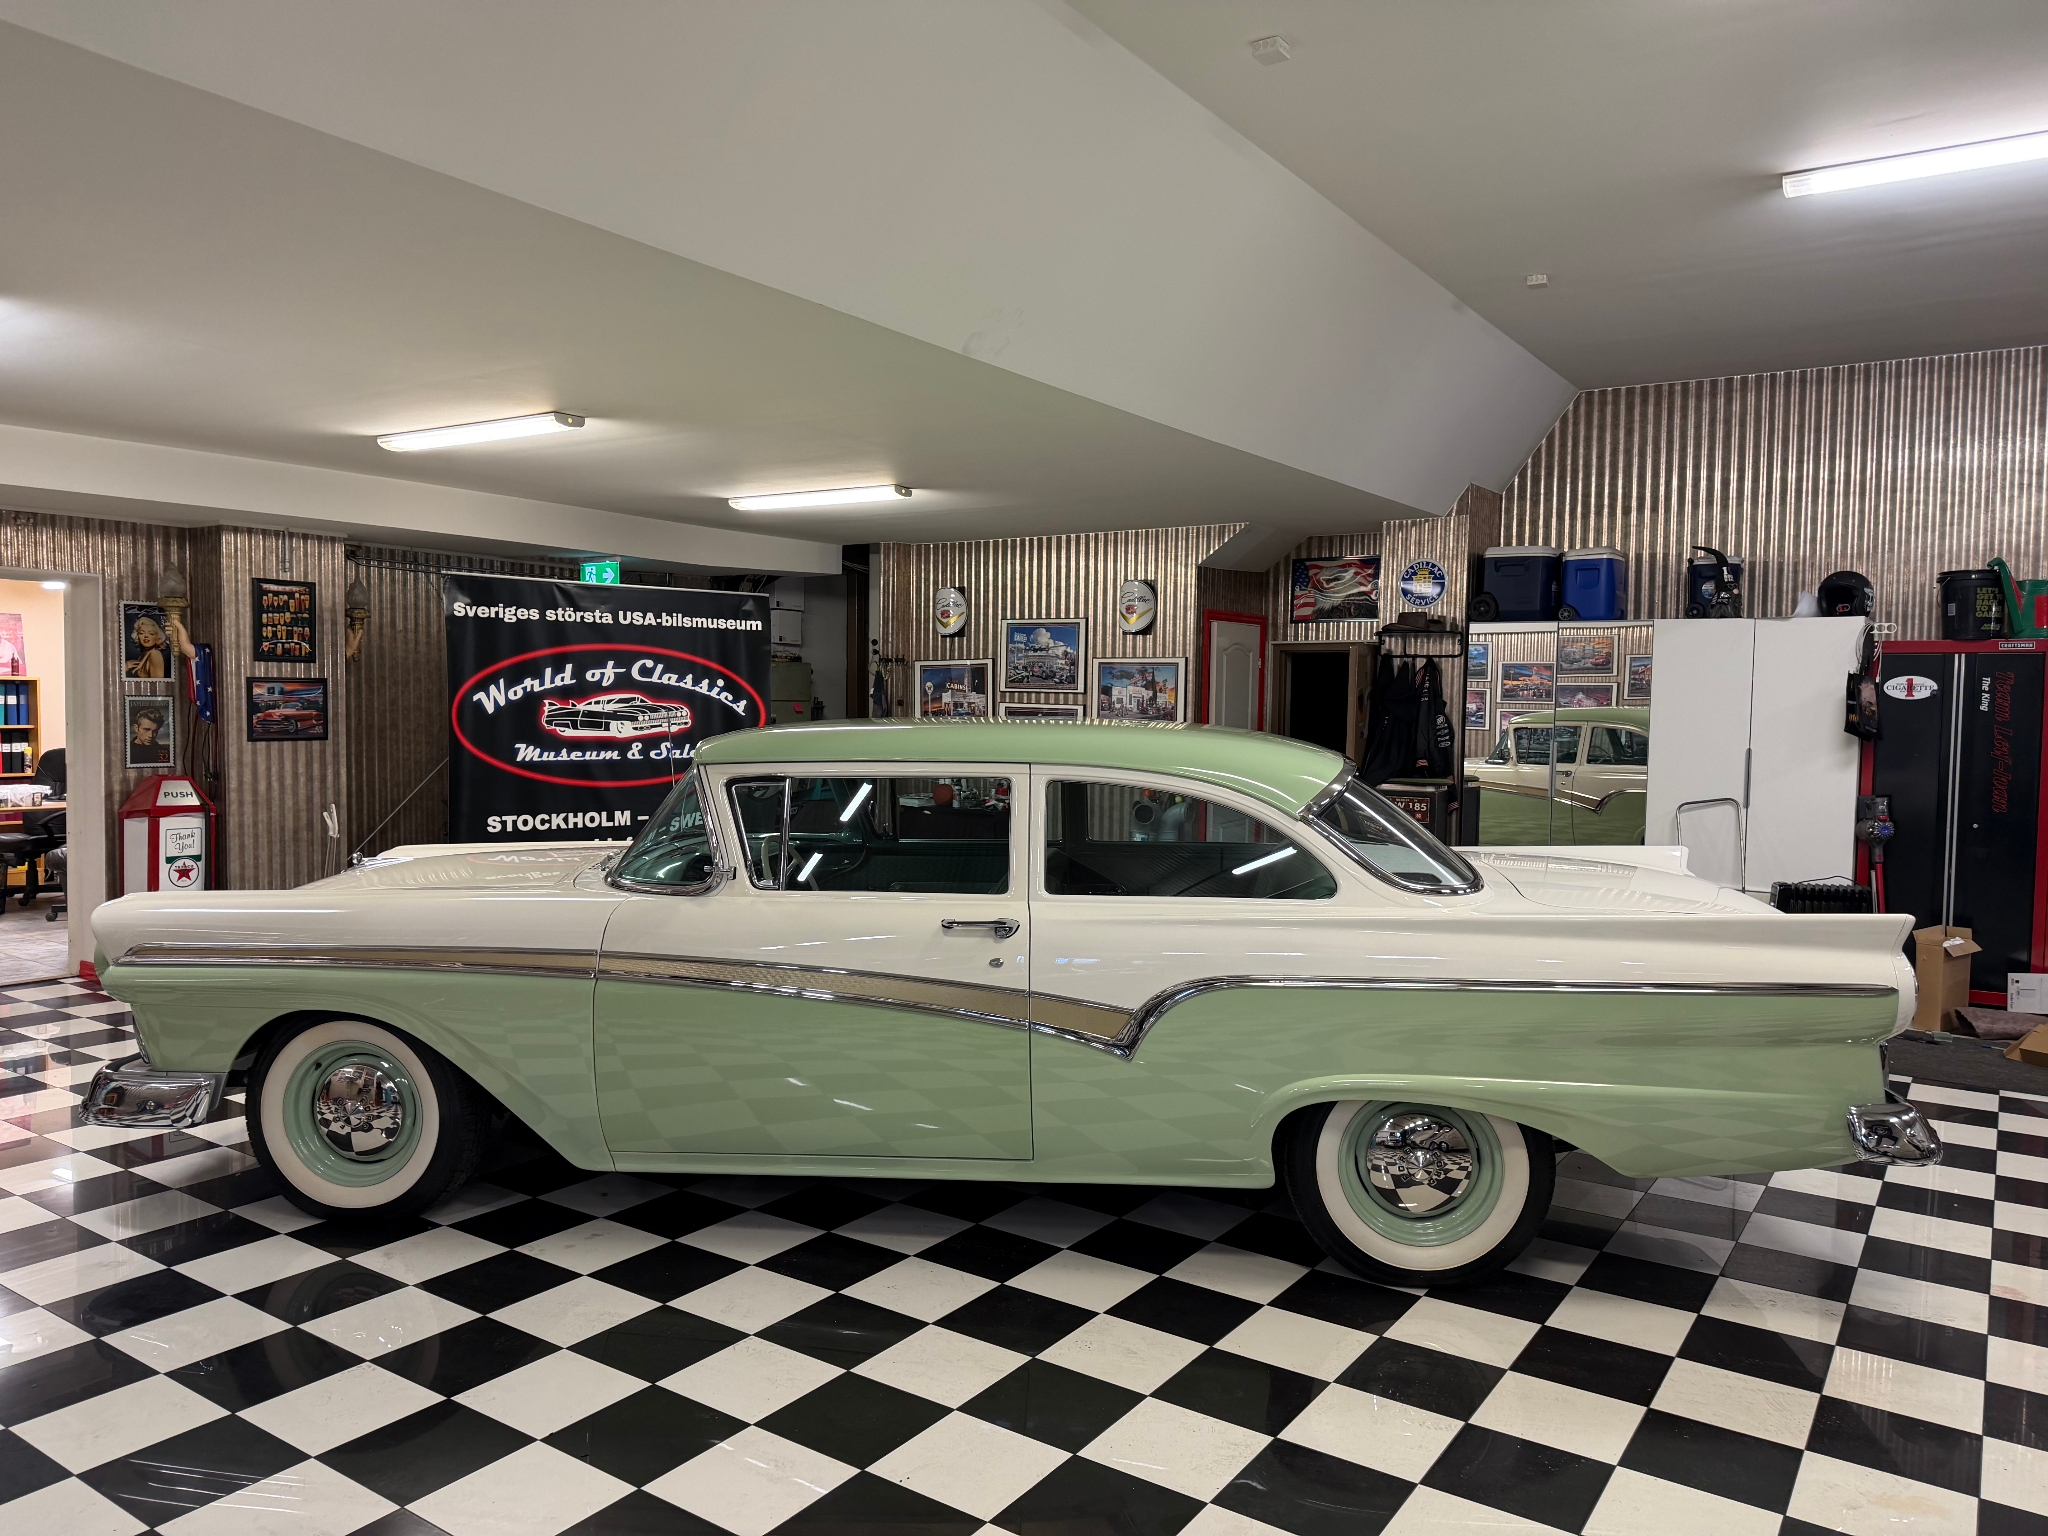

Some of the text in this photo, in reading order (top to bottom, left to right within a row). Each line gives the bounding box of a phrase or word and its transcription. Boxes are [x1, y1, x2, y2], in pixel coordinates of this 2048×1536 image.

[1403, 561, 1443, 579] CADILLAC
[1121, 591, 1151, 605] Cadillac
[1405, 593, 1439, 606] SERVICE
[453, 601, 763, 631] Sveriges största USA-bilsmuseum
[472, 659, 748, 716] World of Classics
[1979, 677, 1991, 712] The King
[1995, 671, 2015, 722] Team
[514, 743, 622, 762] Museum
[627, 742, 644, 760] &
[163, 791, 194, 799] PUSH
[1408, 802, 1427, 812] 185
[486, 809, 632, 833] STOCKHOLM
[669, 811, 704, 832] SWE
[169, 829, 196, 844] Thank
[174, 839, 195, 854] You!
